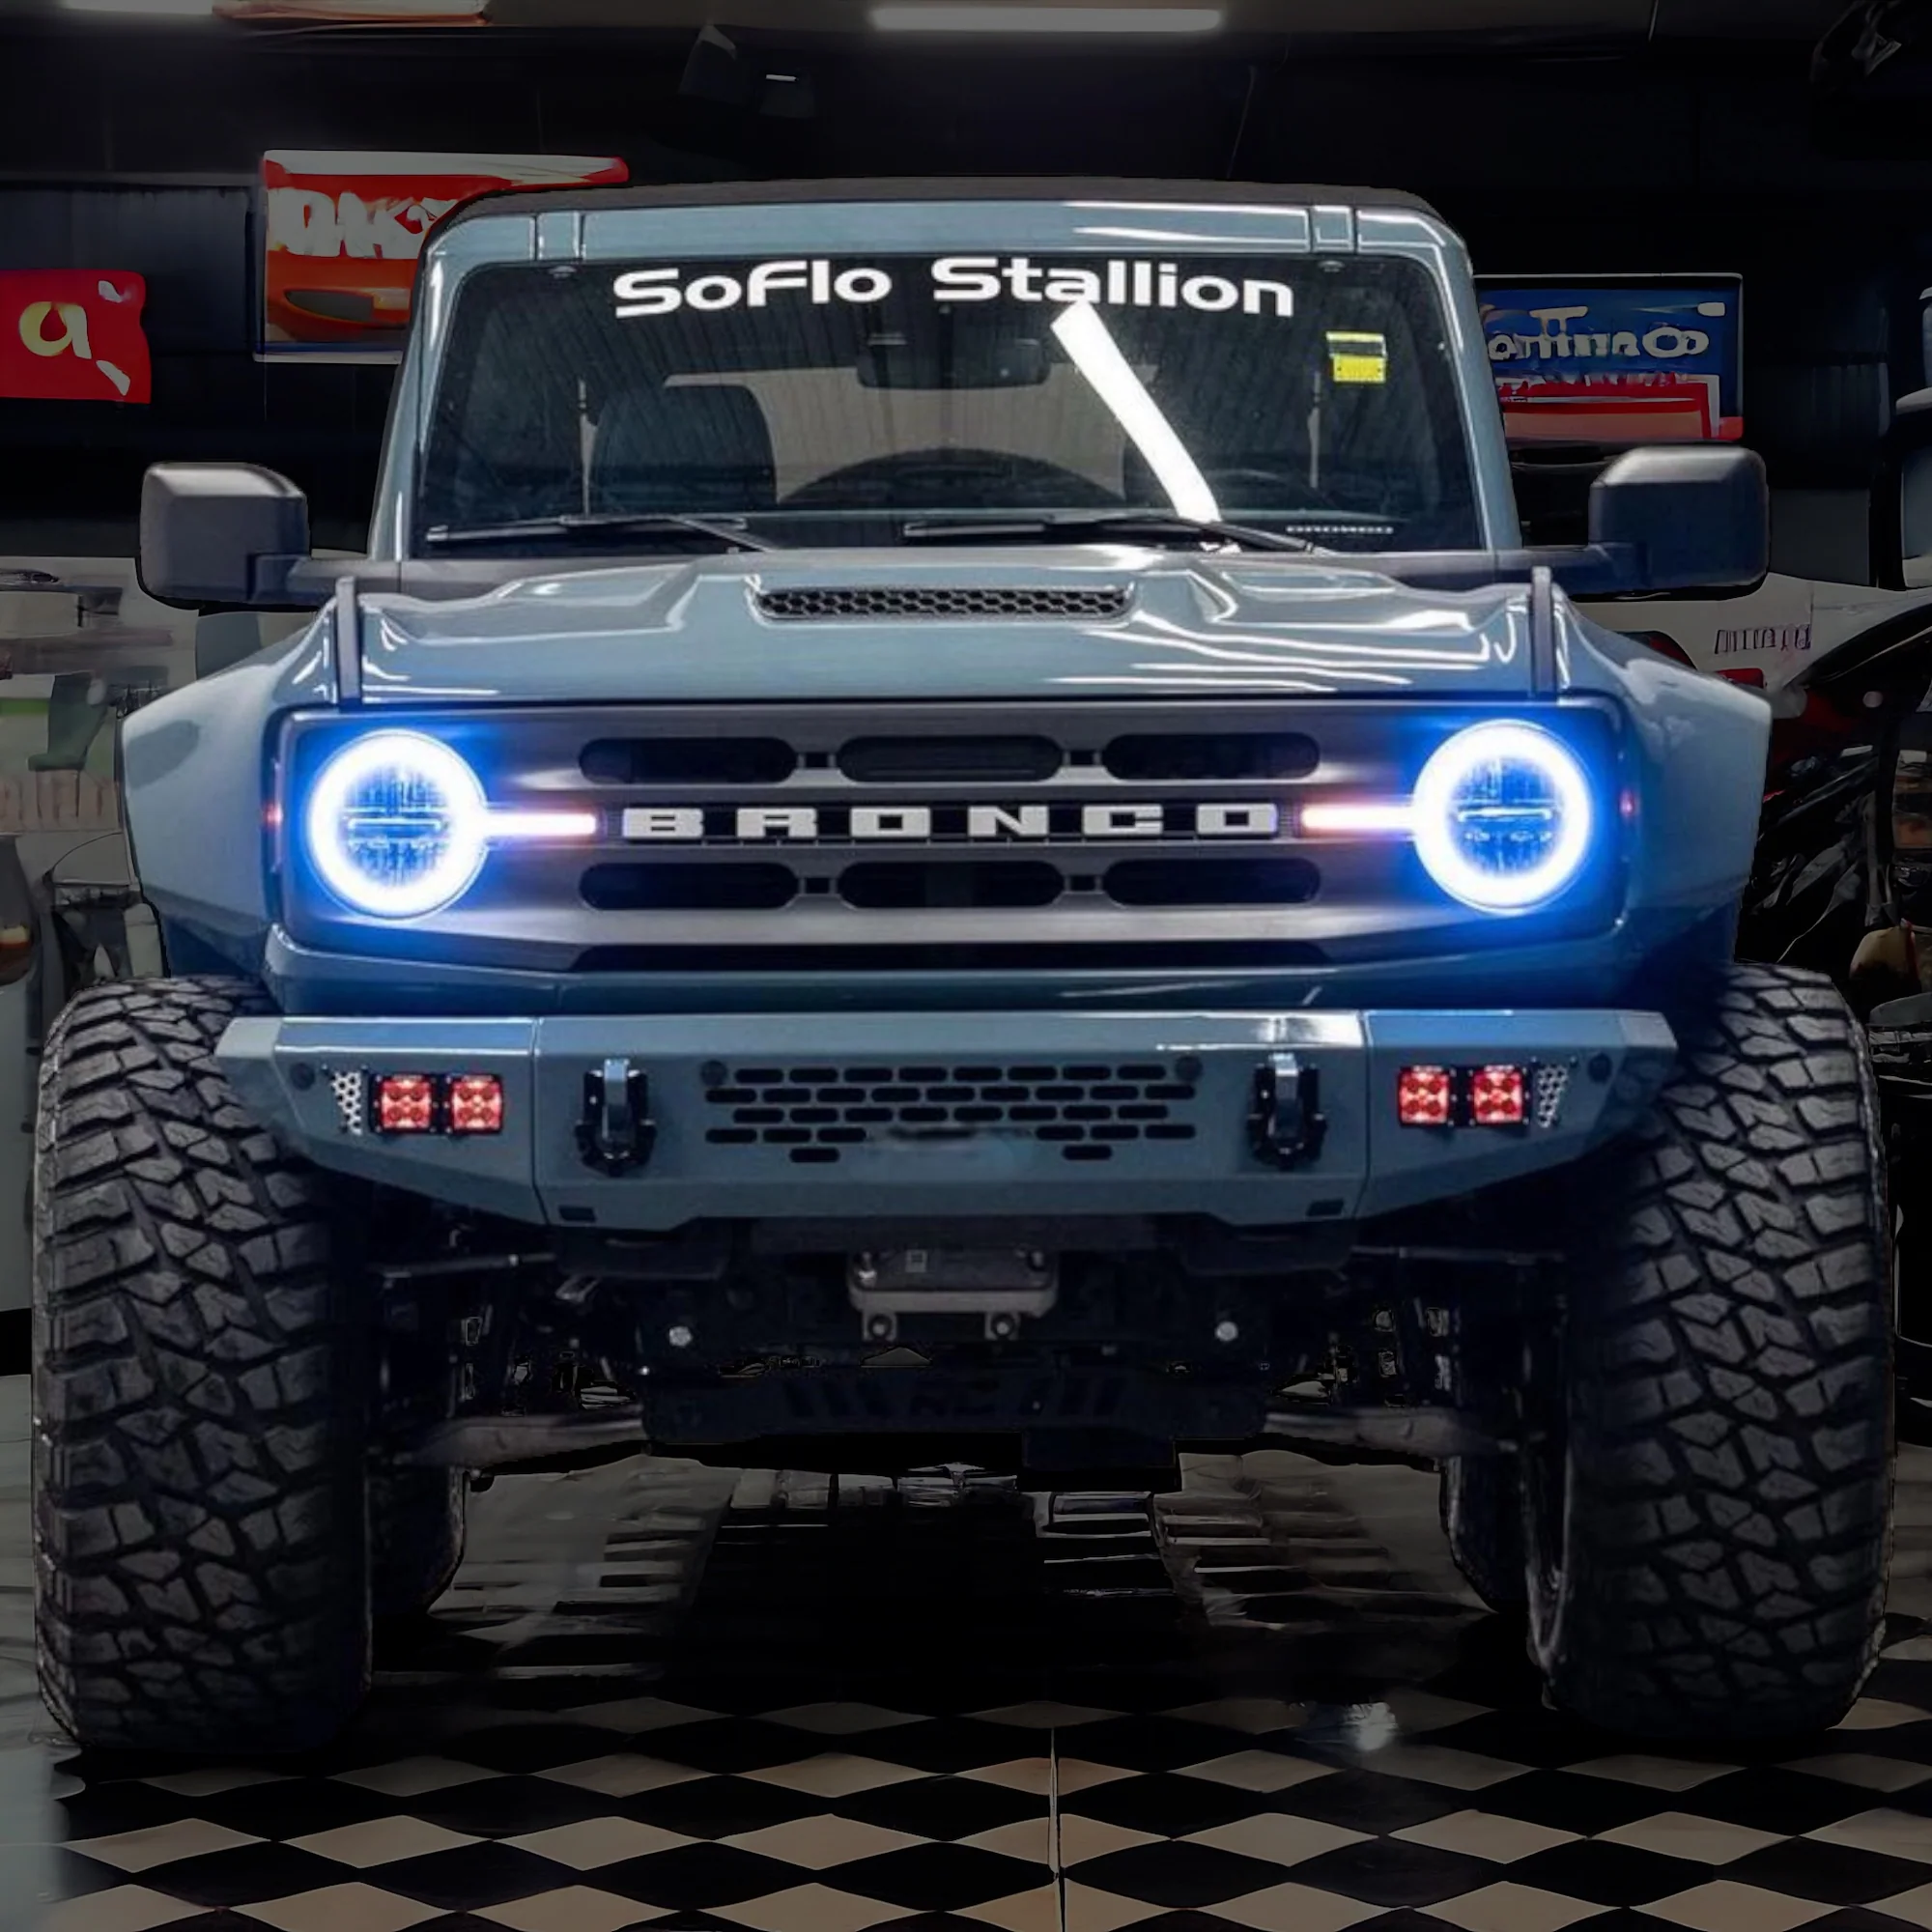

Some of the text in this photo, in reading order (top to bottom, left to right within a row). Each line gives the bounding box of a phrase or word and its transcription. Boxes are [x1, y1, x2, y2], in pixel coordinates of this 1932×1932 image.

[612, 256, 1294, 319] SoFlo Stallion
[621, 803, 1278, 838] BRONCO
